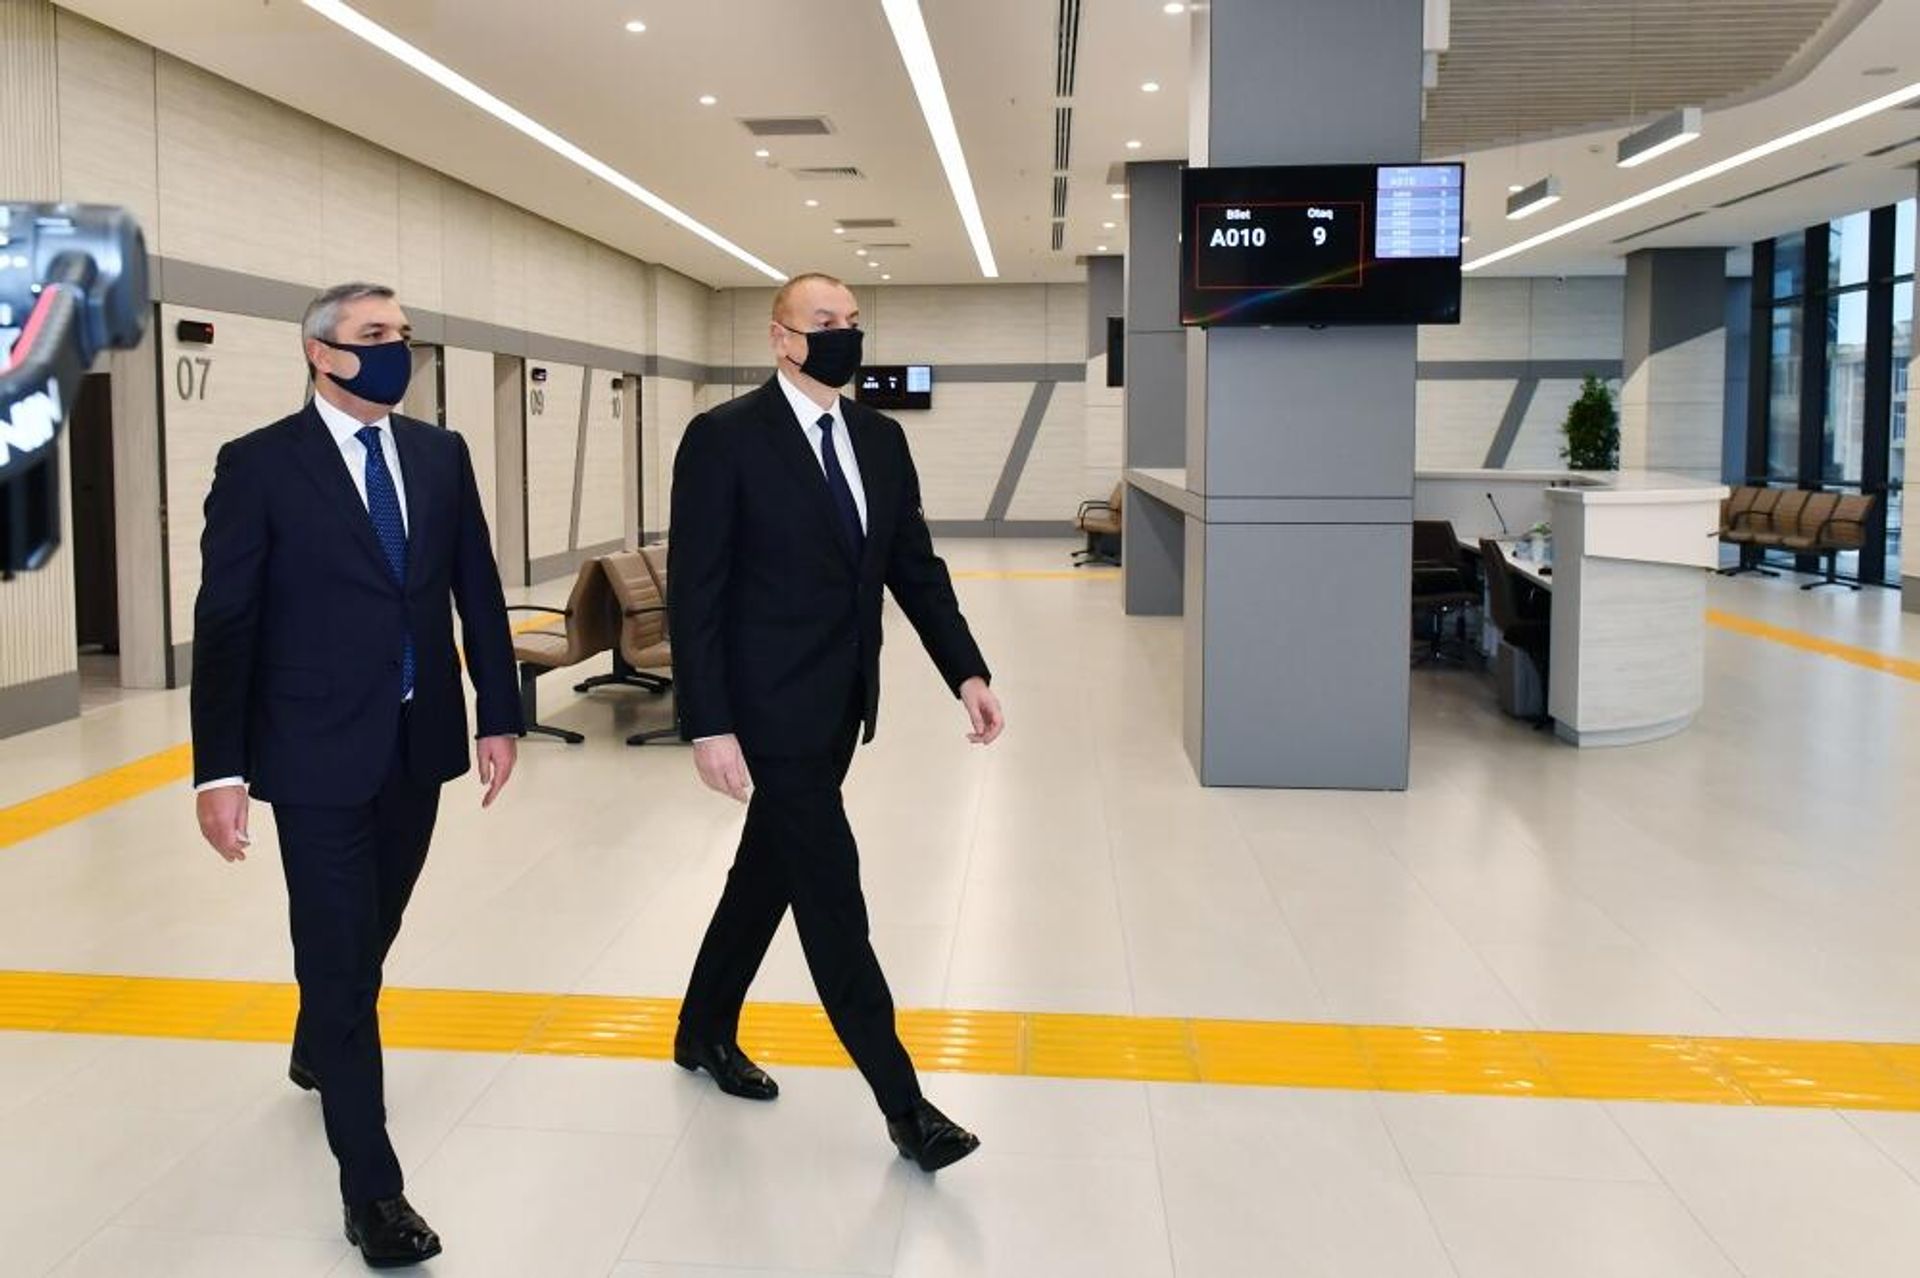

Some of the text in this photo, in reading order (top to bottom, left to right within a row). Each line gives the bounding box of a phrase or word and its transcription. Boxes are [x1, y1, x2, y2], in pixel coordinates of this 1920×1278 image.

[1307, 207, 1333, 220] Otaq
[1209, 226, 1326, 247] A010 9
[177, 356, 211, 400] 07
[530, 388, 544, 415] 09
